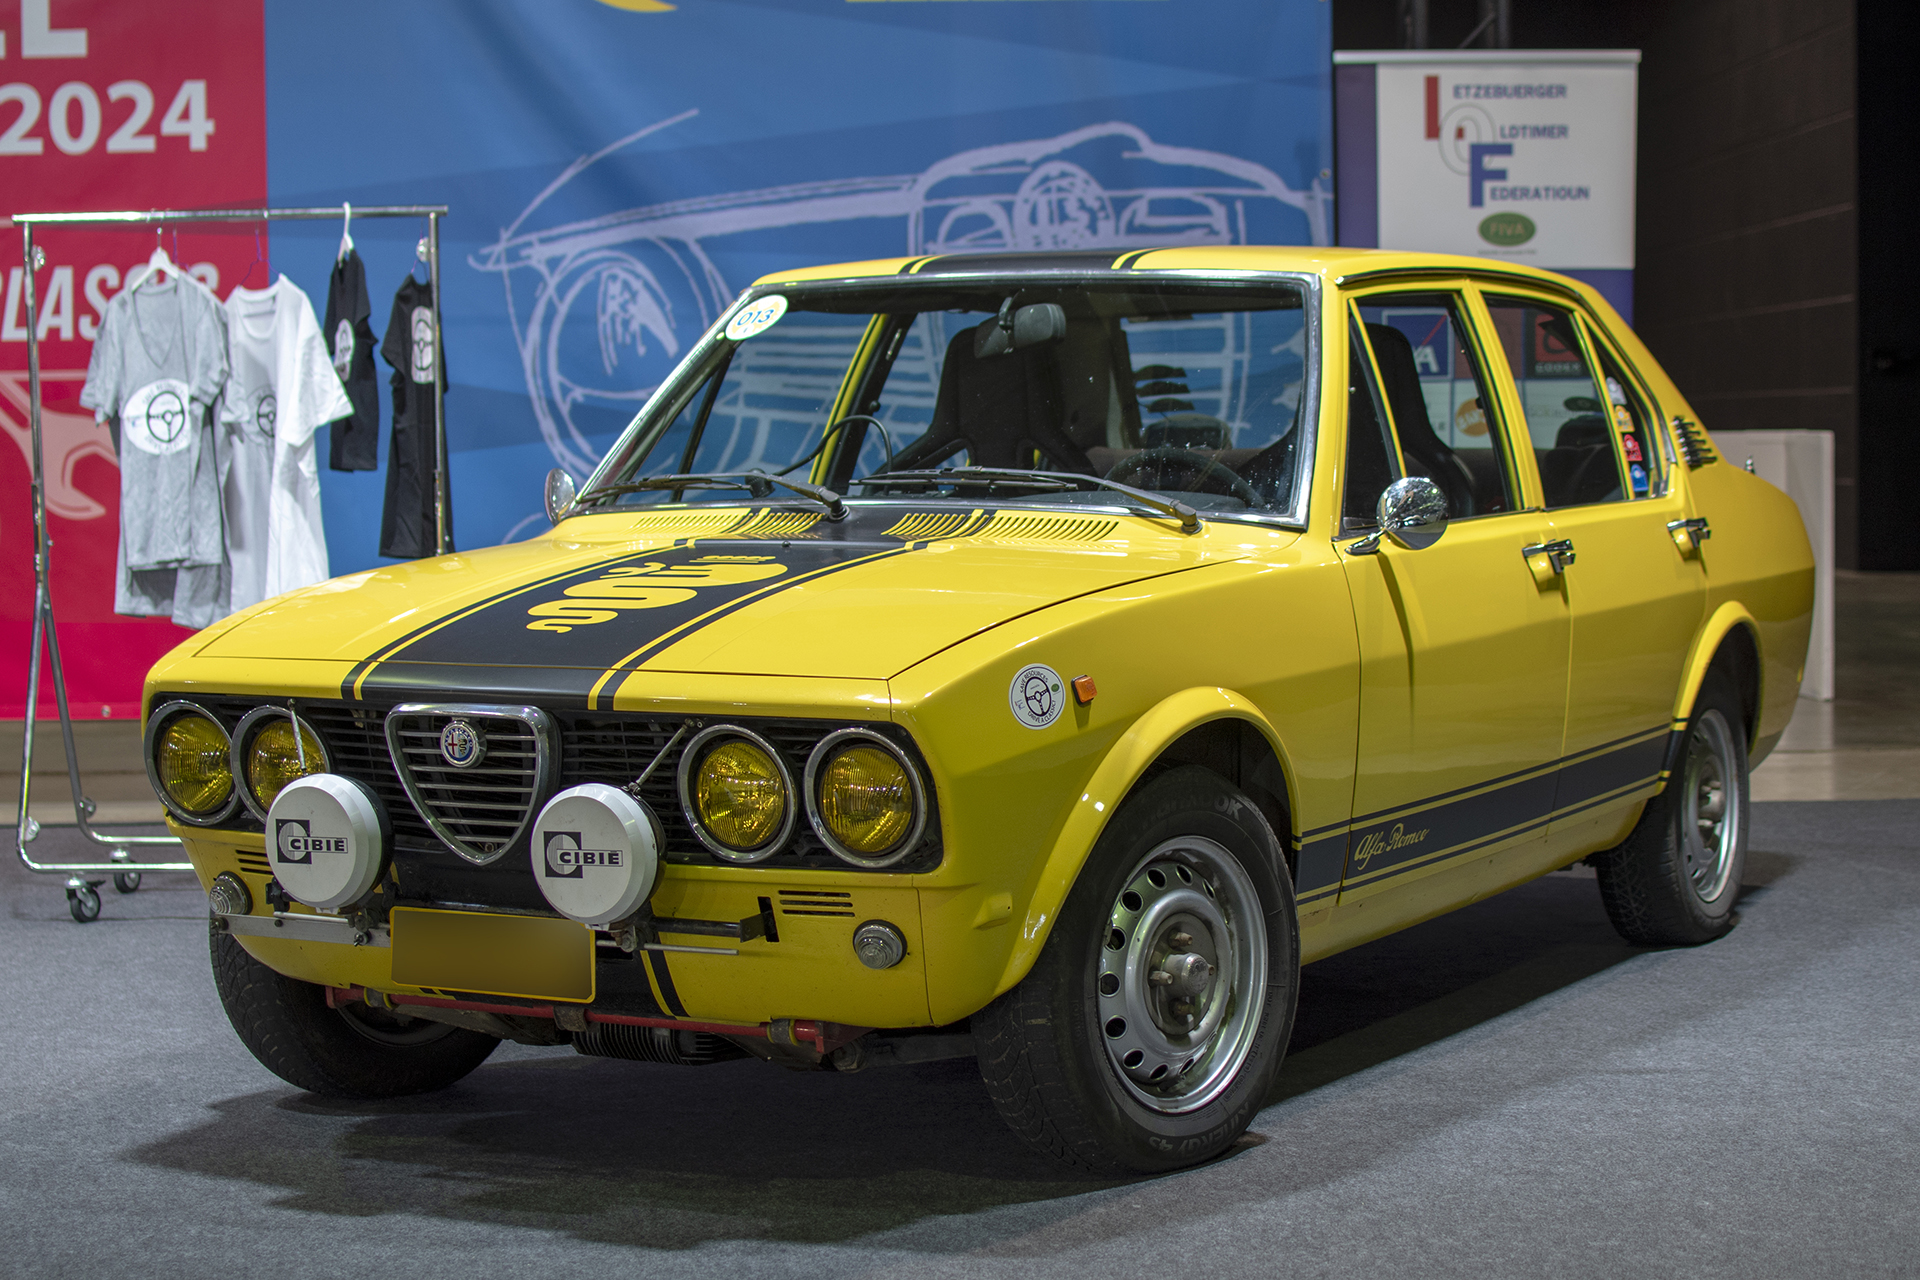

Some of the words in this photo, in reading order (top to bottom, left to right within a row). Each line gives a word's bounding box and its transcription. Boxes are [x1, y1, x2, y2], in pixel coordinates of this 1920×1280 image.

[0, 80, 215, 156] 2024
[737, 309, 775, 326] 013
[1354, 831, 1387, 870] Alfa
[1386, 823, 1430, 851] Romeo
